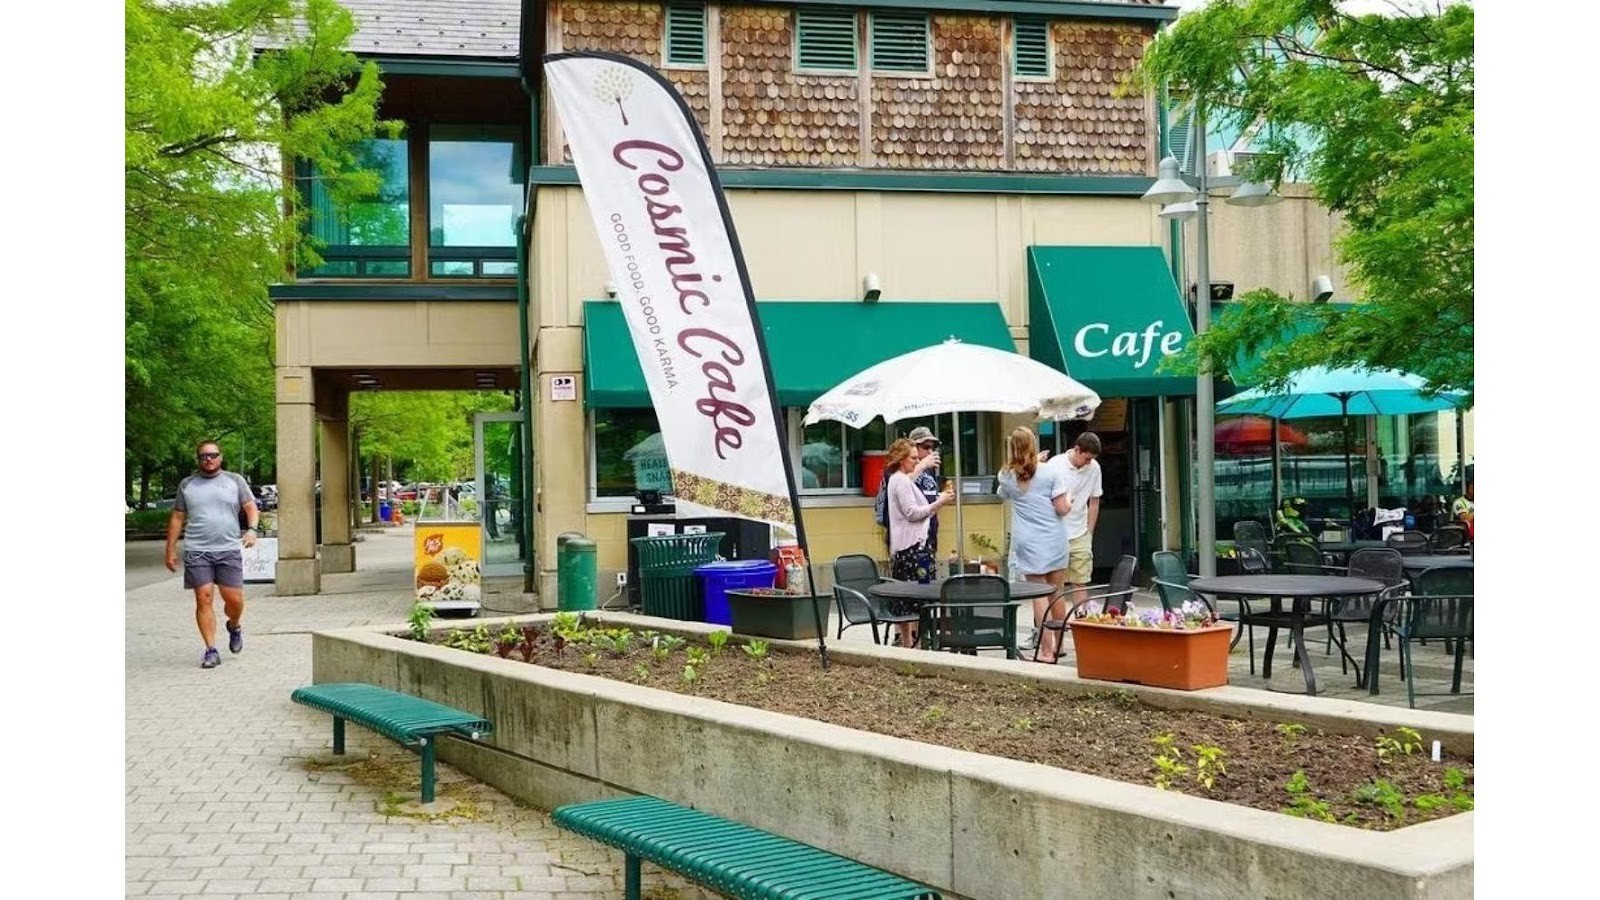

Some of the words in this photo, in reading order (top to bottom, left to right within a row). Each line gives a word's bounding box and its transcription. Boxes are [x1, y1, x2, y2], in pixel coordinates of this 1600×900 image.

[610, 212, 631, 256] GOOD
[625, 254, 645, 294] FOOD.
[639, 295, 662, 336] GOOD
[653, 337, 679, 395] KARMA.
[612, 139, 722, 316] Cosmic
[676, 327, 757, 461] Cafe
[1074, 319, 1183, 369] Cafe
